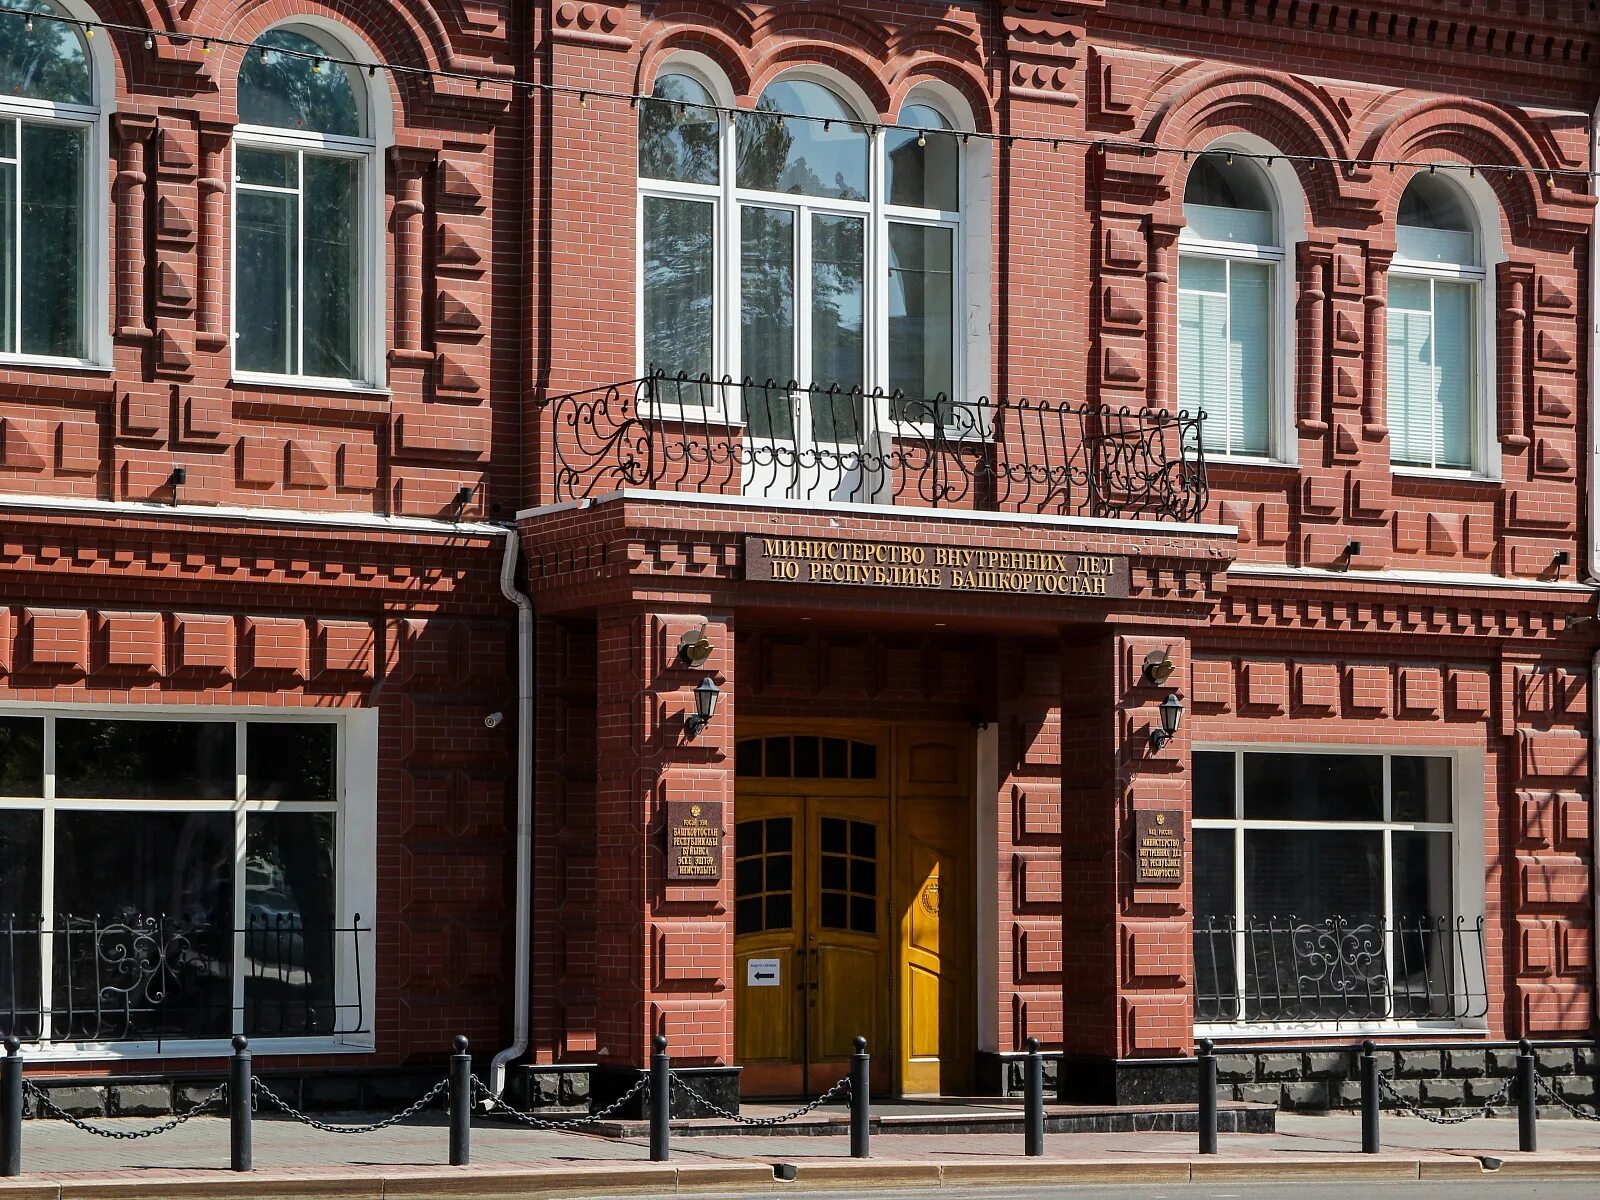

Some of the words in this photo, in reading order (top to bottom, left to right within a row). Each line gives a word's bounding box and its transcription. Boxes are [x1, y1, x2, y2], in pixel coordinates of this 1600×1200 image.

[763, 539, 925, 565] МИНИСТЕРСТВО
[936, 548, 1067, 573] ВНУТРЕННИХ
[1076, 556, 1114, 576] ДЕЛ
[771, 561, 799, 580] ПО
[809, 563, 941, 587] РЕСПУБЛИКЕ
[951, 570, 1106, 595] БАШКОРТОСТАН
[1142, 839, 1180, 847] МИНИСТЕРСТВО
[1139, 849, 1170, 857] ВНУТРЕННИХ
[1172, 849, 1182, 858] ДЕЛ
[1141, 859, 1148, 867] ПО
